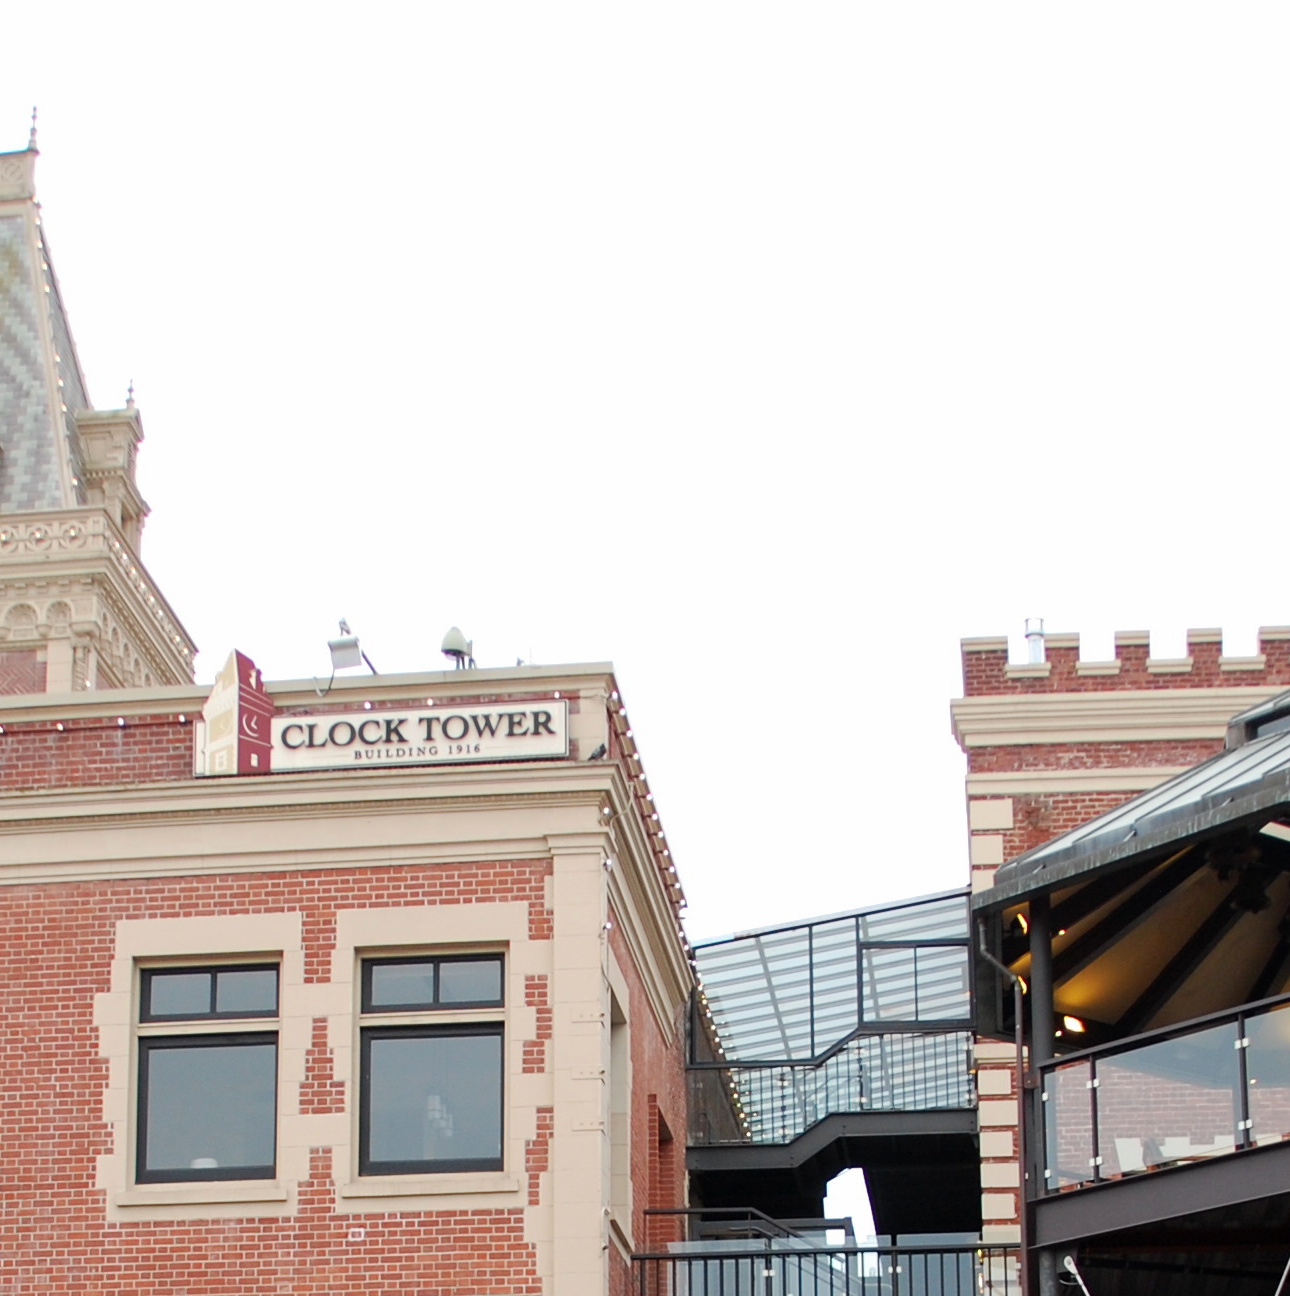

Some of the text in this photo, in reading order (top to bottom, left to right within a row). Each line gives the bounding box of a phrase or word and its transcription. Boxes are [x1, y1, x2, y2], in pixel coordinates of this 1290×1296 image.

[280, 709, 556, 749] CLOCK TOWER
[354, 744, 481, 760] BUILDING 1916
